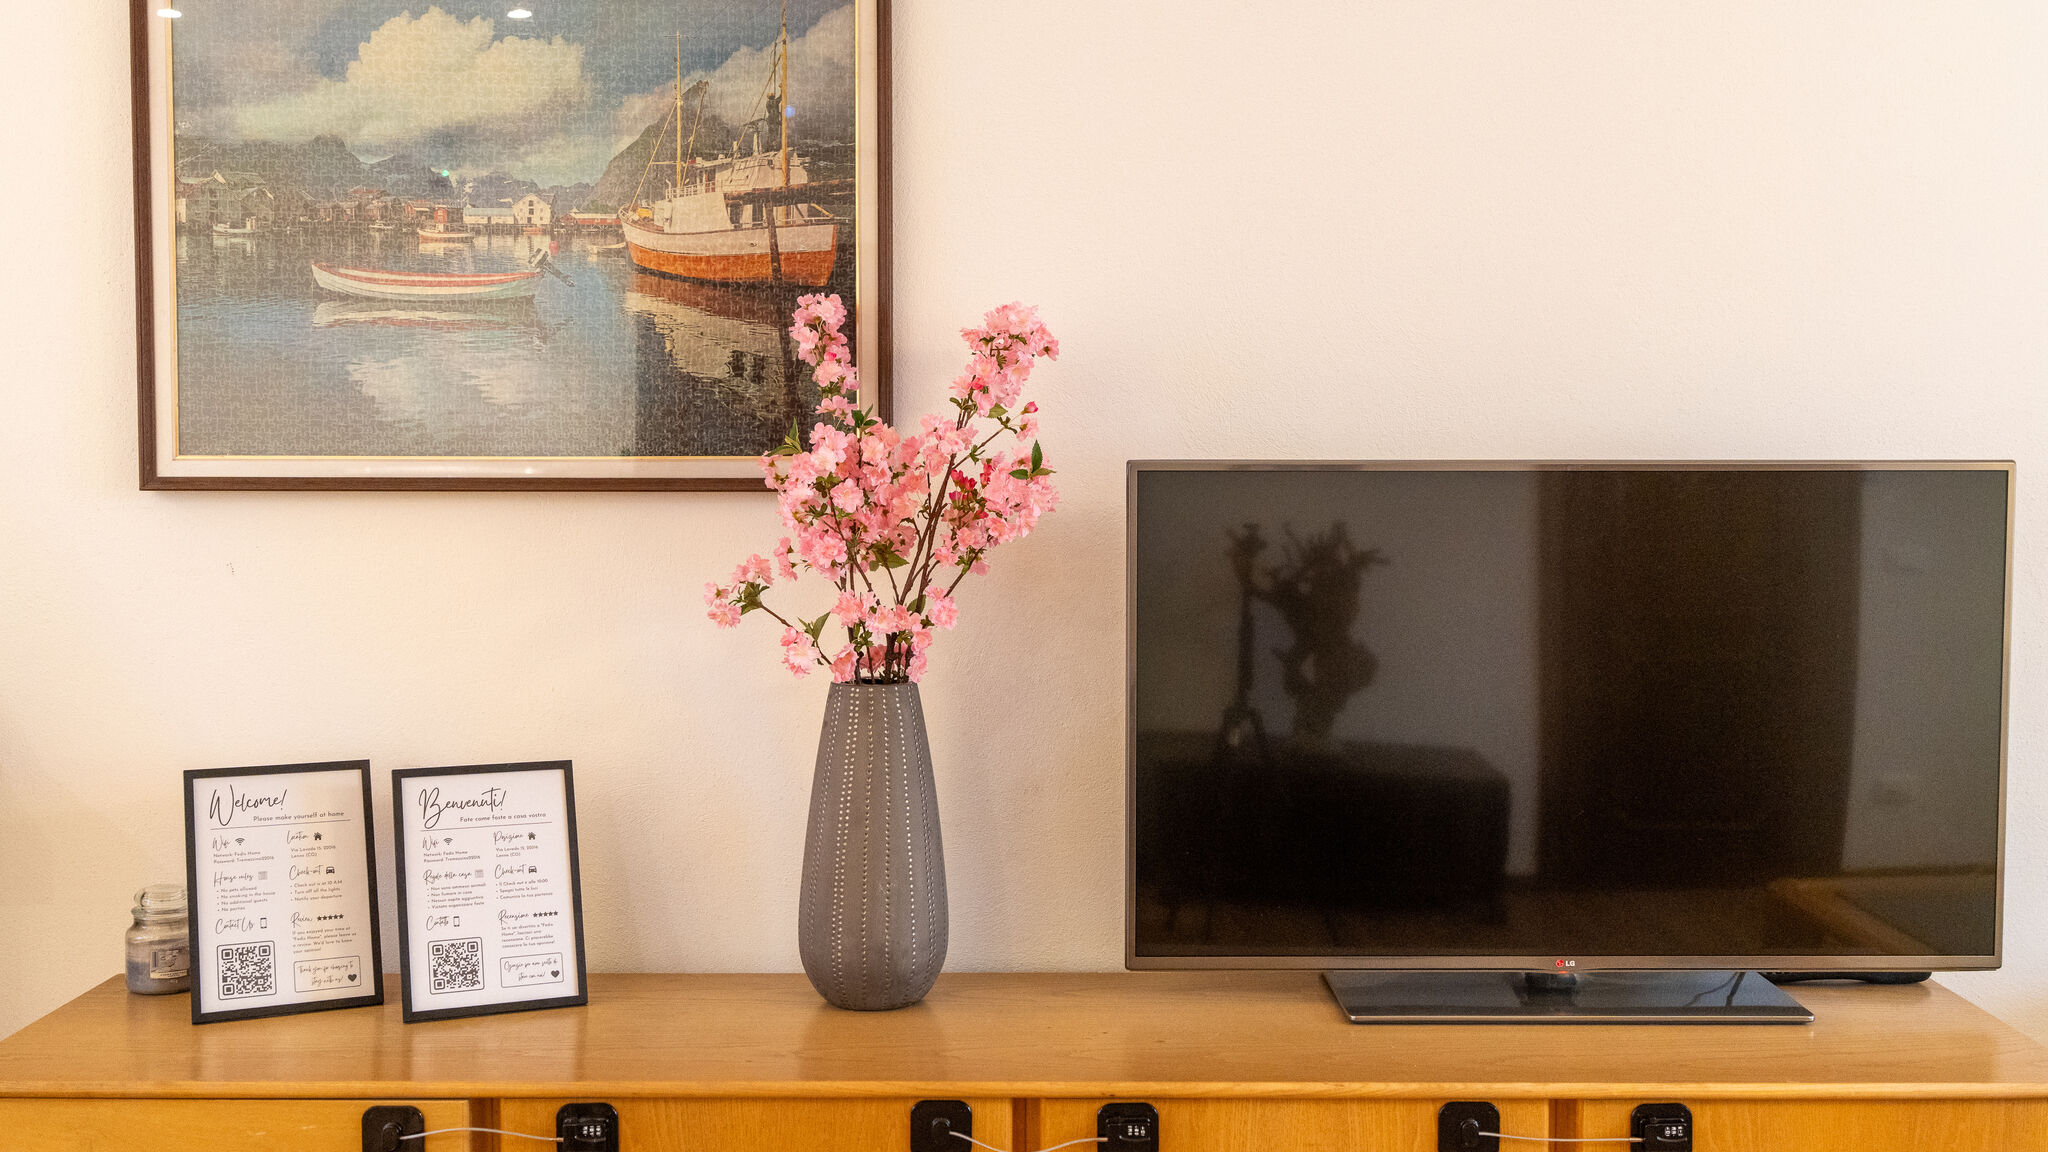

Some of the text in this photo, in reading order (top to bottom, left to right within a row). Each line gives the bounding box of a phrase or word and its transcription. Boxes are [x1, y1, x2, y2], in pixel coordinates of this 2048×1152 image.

[210, 784, 287, 826] Welcome!
[293, 812, 318, 820] yourself
[419, 787, 506, 829] Benvenuti!
